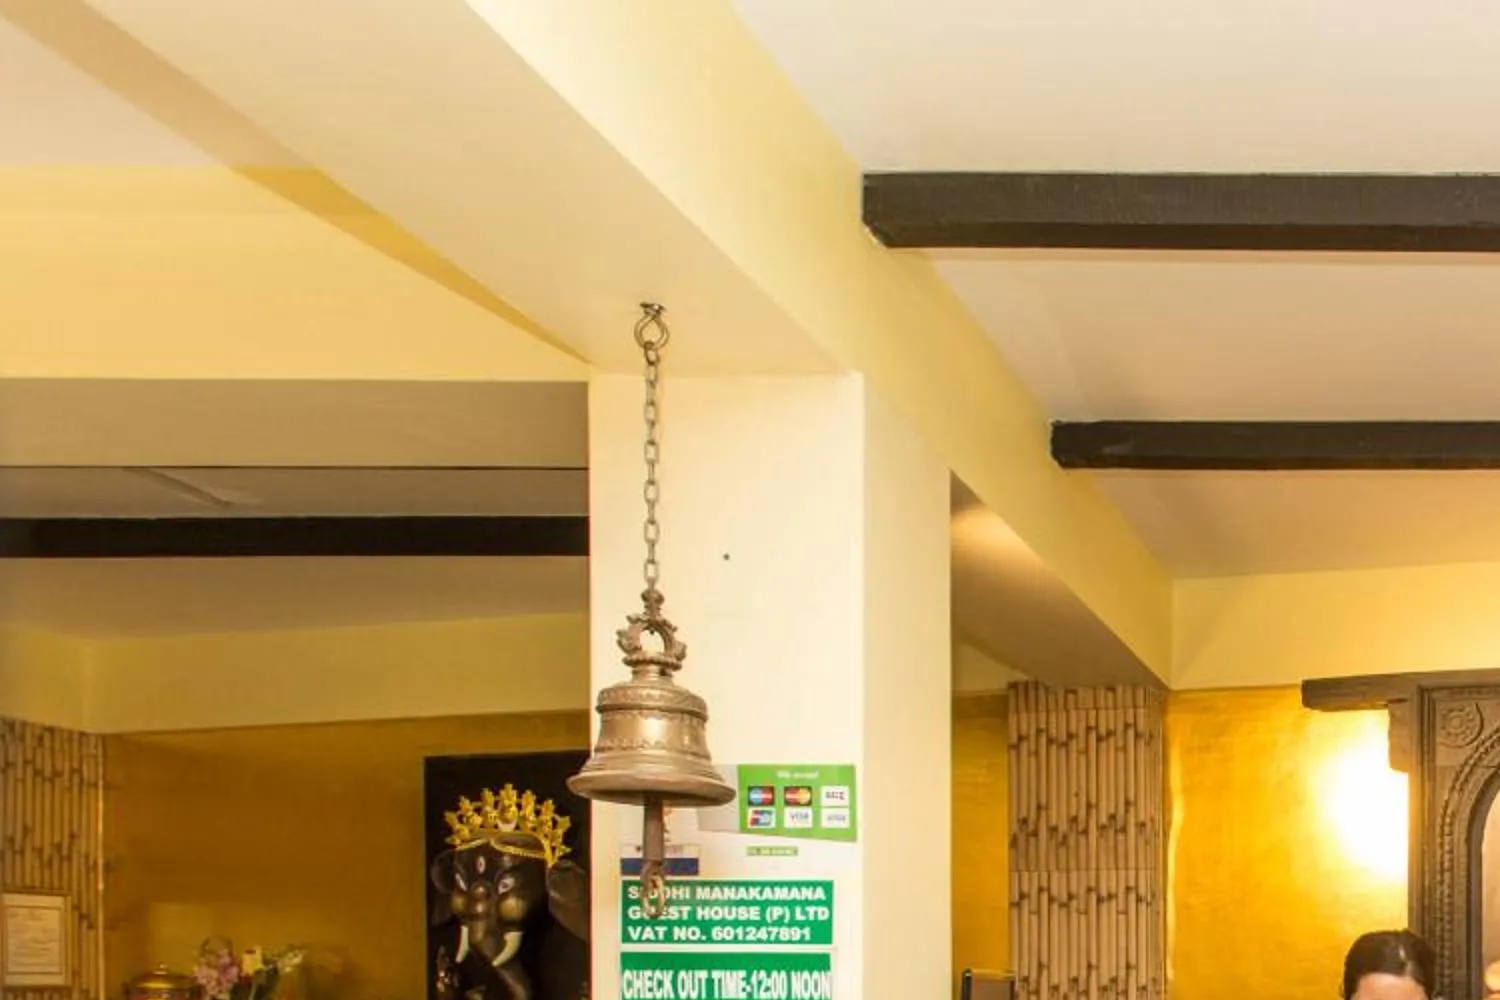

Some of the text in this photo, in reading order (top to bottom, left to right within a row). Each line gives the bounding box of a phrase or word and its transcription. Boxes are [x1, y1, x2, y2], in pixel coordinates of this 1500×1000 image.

[696, 886, 827, 901] MANAKAMANA
[696, 905, 761, 921] HOUSE
[765, 905, 791, 924] (P)
[795, 905, 830, 921] LTD
[627, 925, 669, 941] VAT
[673, 925, 707, 941] NO.
[623, 969, 675, 1000] CHECK
[677, 969, 709, 1000] OUT
[790, 970, 832, 1000] NOON
